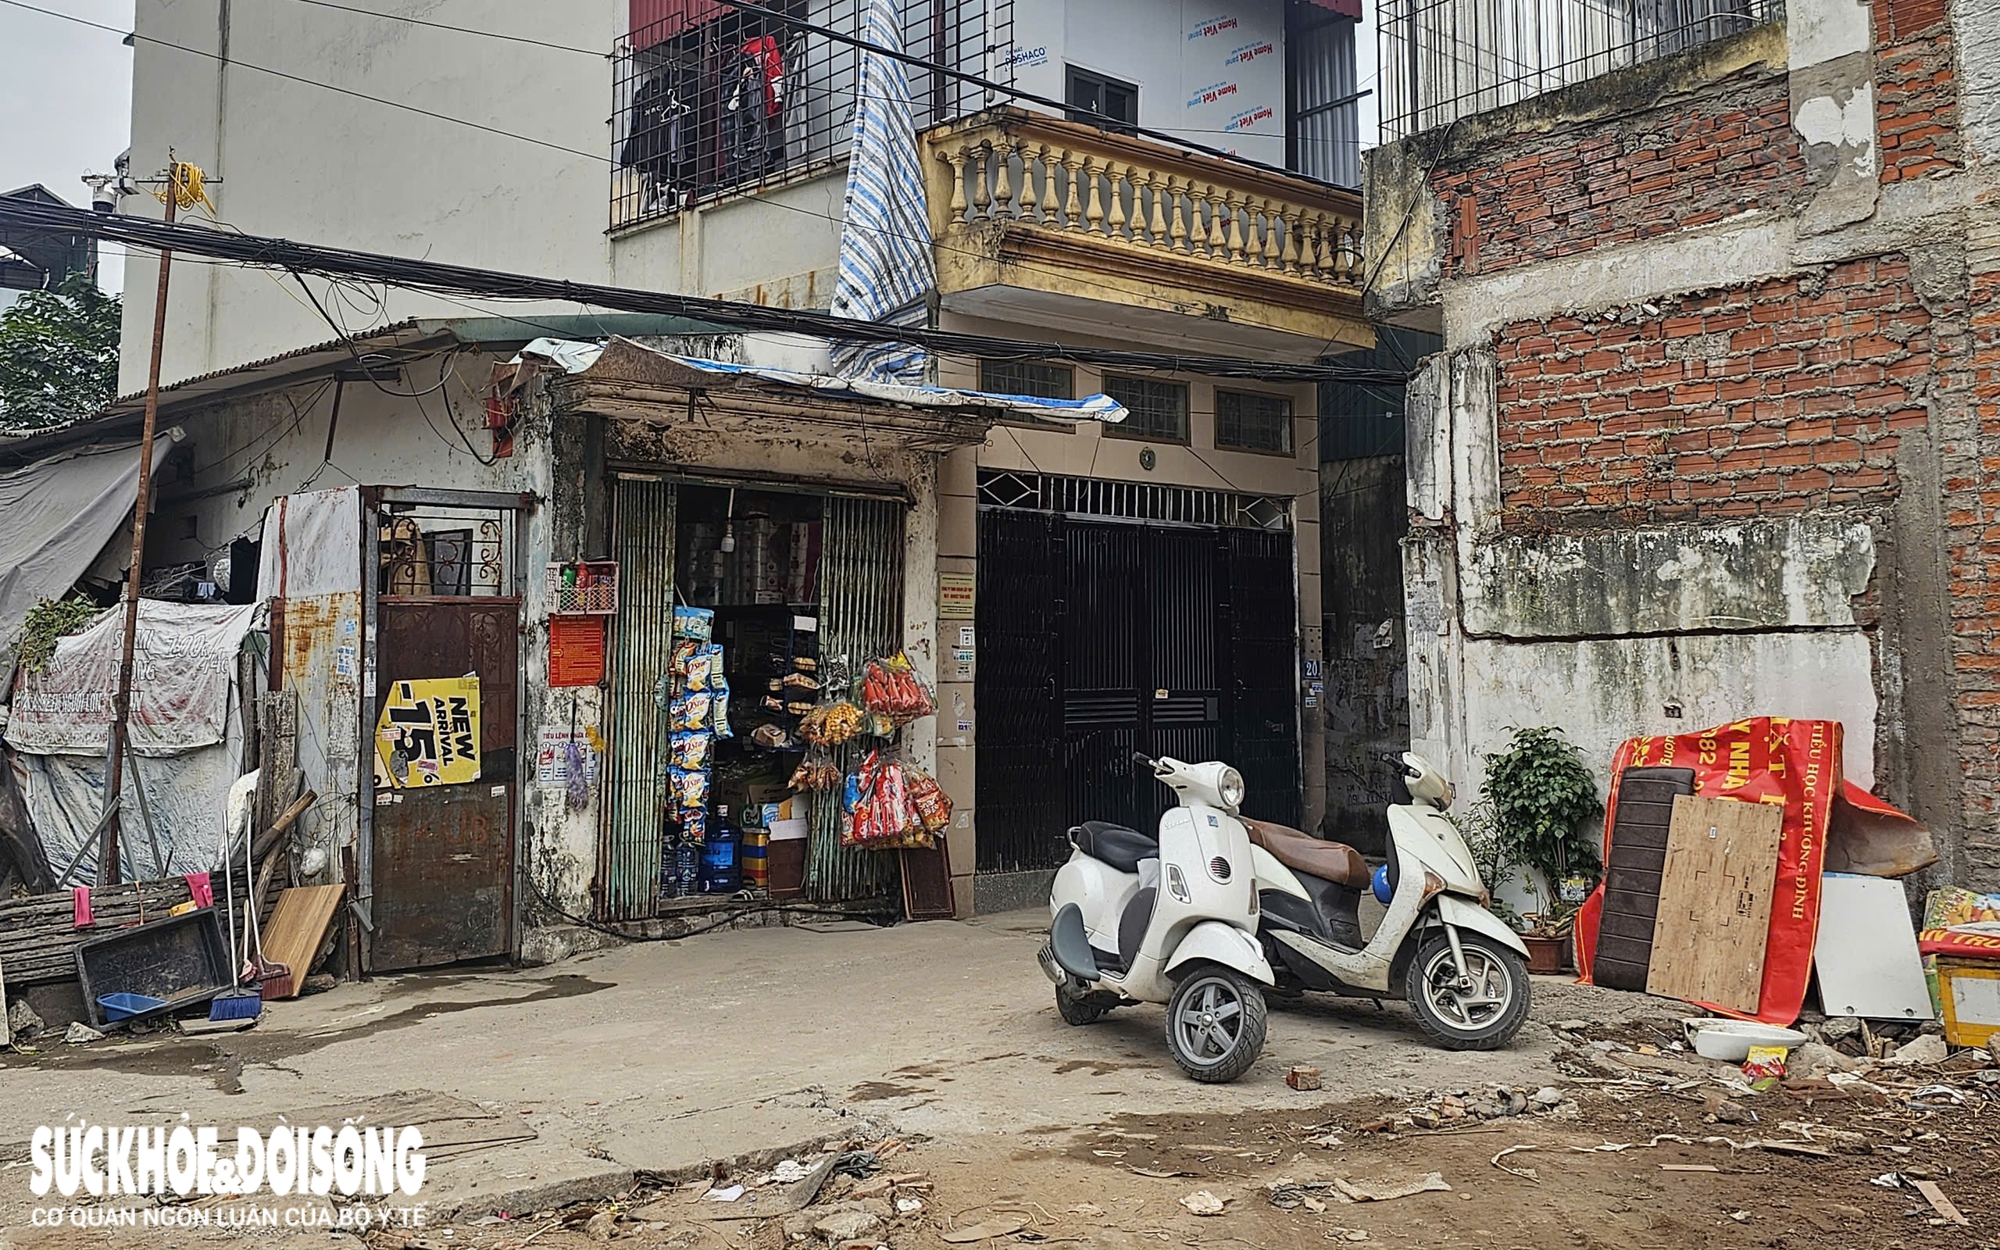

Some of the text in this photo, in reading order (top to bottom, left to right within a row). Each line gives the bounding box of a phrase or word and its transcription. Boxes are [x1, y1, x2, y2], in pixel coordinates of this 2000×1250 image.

[1253, 43, 1273, 57] Home
[1217, 83, 1237, 97] Home
[1253, 107, 1273, 122] Home
[1306, 660, 1318, 677] 20
[433, 697, 454, 767] ARRIVAL
[448, 697, 476, 761] NEW
[1721, 742, 1751, 789] NHÀ
[1792, 722, 1826, 919] TIỂU HỌC KHƯƠNG ĐÌNH
